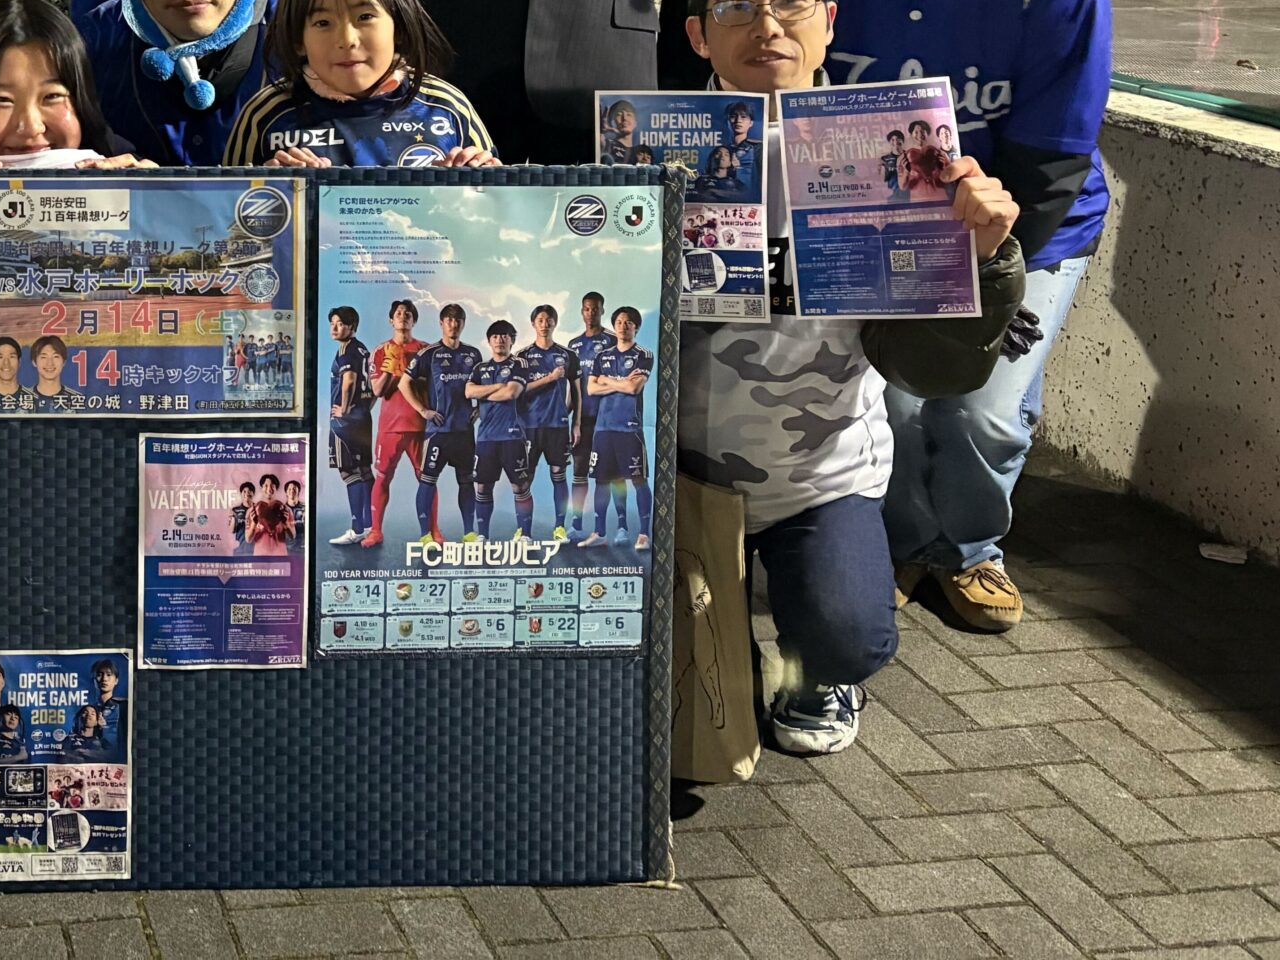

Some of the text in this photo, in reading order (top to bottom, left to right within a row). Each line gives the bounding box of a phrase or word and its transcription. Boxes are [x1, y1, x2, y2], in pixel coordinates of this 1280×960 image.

[787, 87, 944, 108] 百年構想リーグホームゲーム開幕戦
[382, 119, 426, 133] avex
[650, 112, 712, 129] OPENING
[270, 127, 345, 151] RUDEL
[639, 130, 722, 147] HOME GAME
[663, 148, 699, 165] 2026
[807, 181, 829, 193] 2.14
[39, 196, 87, 209] 明治安田
[338, 197, 421, 206] FC町田ゼルビアがつなぐ
[338, 207, 383, 216] 未来のかたち
[16, 267, 241, 296] 水戸ホーリーホック
[72, 349, 242, 389] 14時キックオフ
[152, 442, 300, 454] 百年構想リーグホームゲーム開幕戦
[430, 446, 439, 461] 3
[162, 529, 181, 541] 2.14
[405, 540, 561, 567] FC町田ゼルビア
[324, 569, 422, 579] 100 YEAR VISION LEAGUE
[577, 567, 600, 575] GAME
[602, 566, 644, 574] SCHEDULE
[355, 584, 381, 598] 2/14
[419, 583, 447, 597] 2/27
[548, 581, 574, 595] 3/18
[612, 581, 635, 594] 4/11
[486, 618, 506, 631] 5/6
[548, 617, 576, 631] 5/22
[605, 616, 625, 630] 6/6
[268, 656, 302, 664] ZELVIA
[18, 672, 79, 689] OPENING
[7, 689, 89, 707] HOME GAME
[30, 708, 66, 725] 2026
